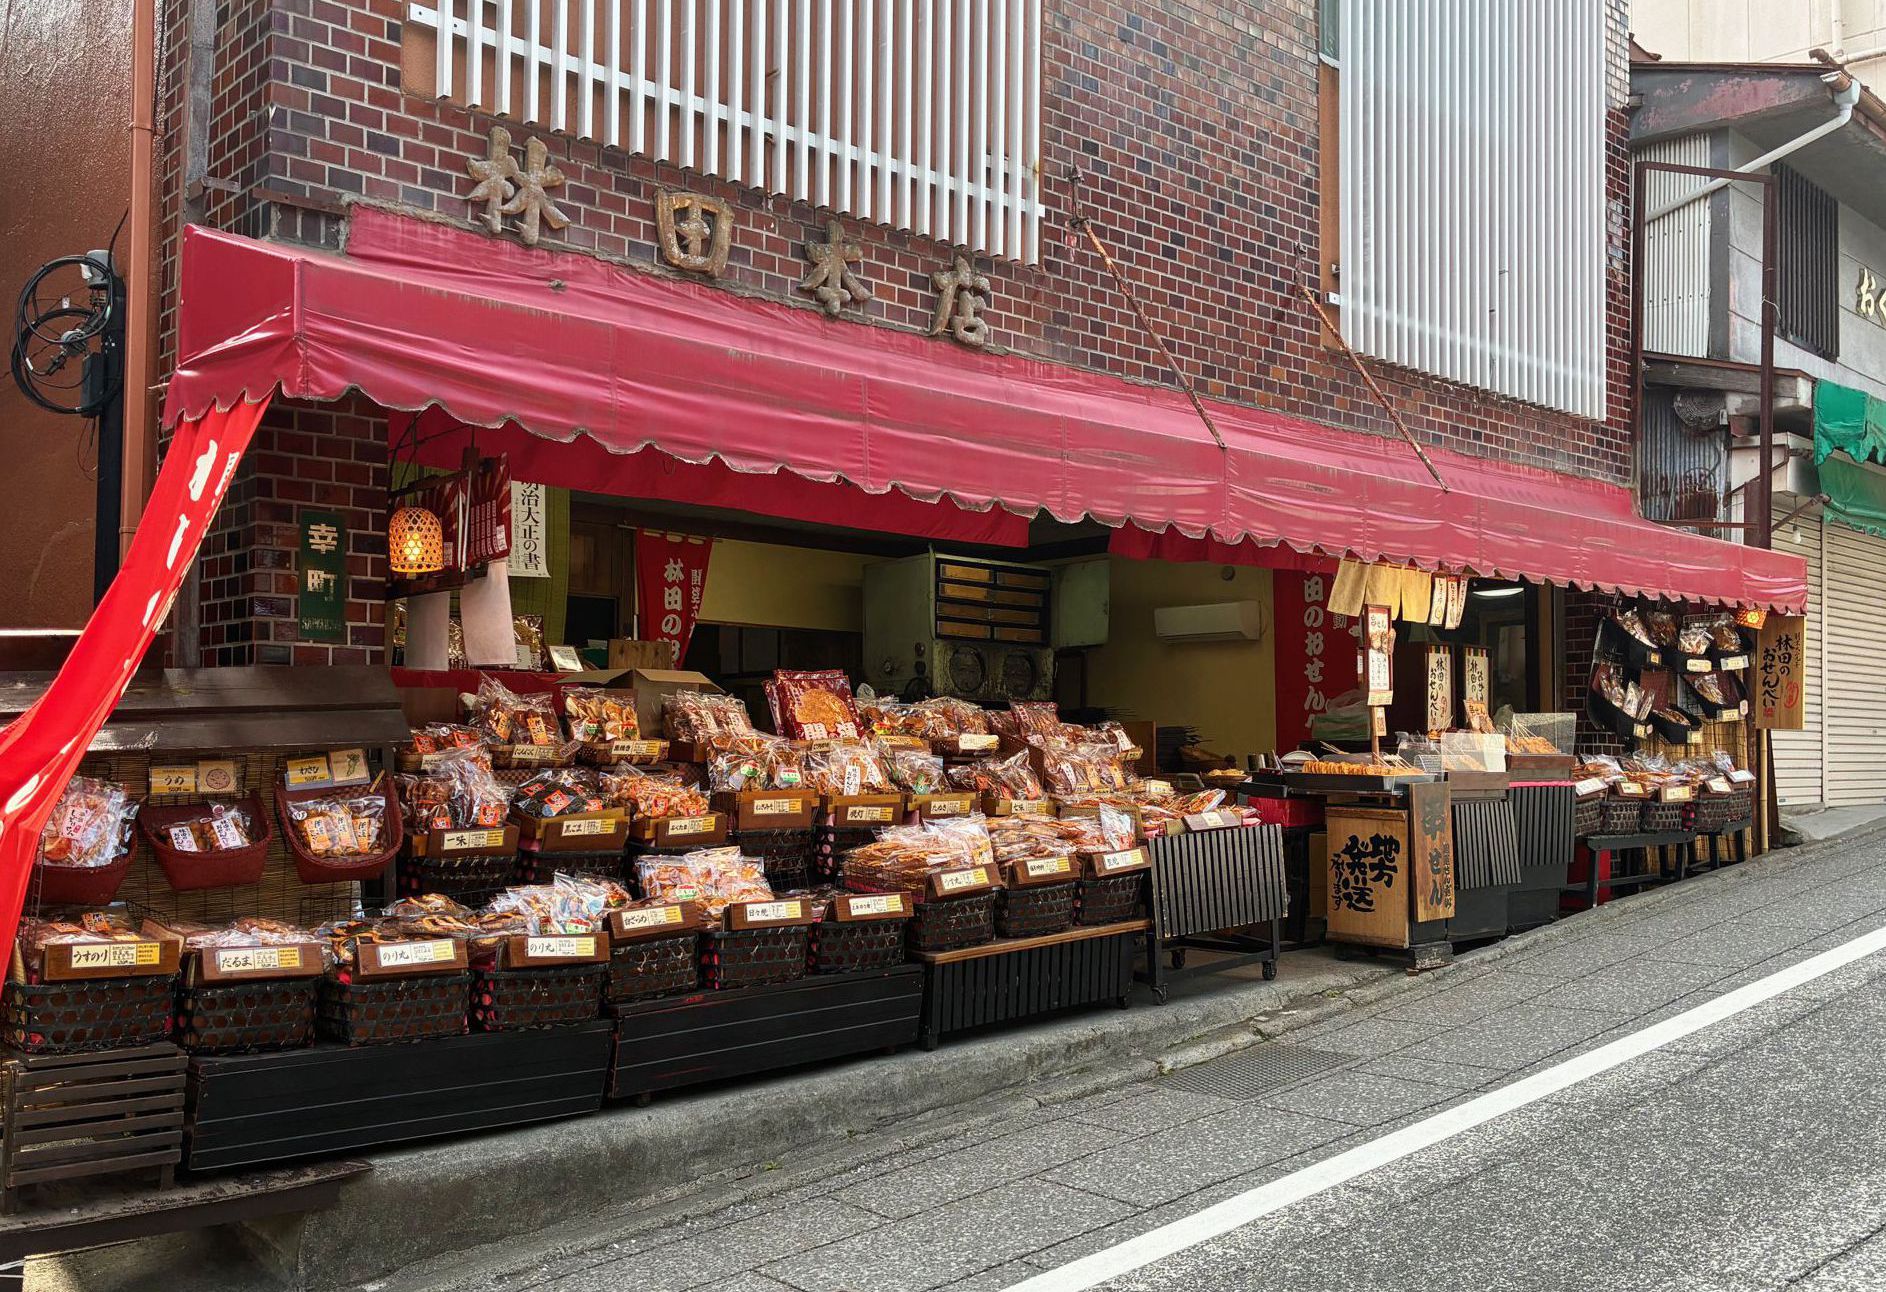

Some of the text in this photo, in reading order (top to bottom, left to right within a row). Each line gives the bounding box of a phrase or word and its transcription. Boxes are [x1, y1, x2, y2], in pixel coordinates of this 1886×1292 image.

[466, 125, 991, 346] 林田本店
[308, 523, 338, 601] 幸町
[1303, 571, 1326, 729] 田のおせん
[1775, 633, 1794, 676] 林田の
[1760, 647, 1780, 708] おせんべい
[164, 774, 185, 786] うめ
[446, 833, 468, 847] 一味
[1369, 832, 1400, 888] 地方
[73, 949, 108, 964] うすのり
[221, 955, 253, 969] だるま
